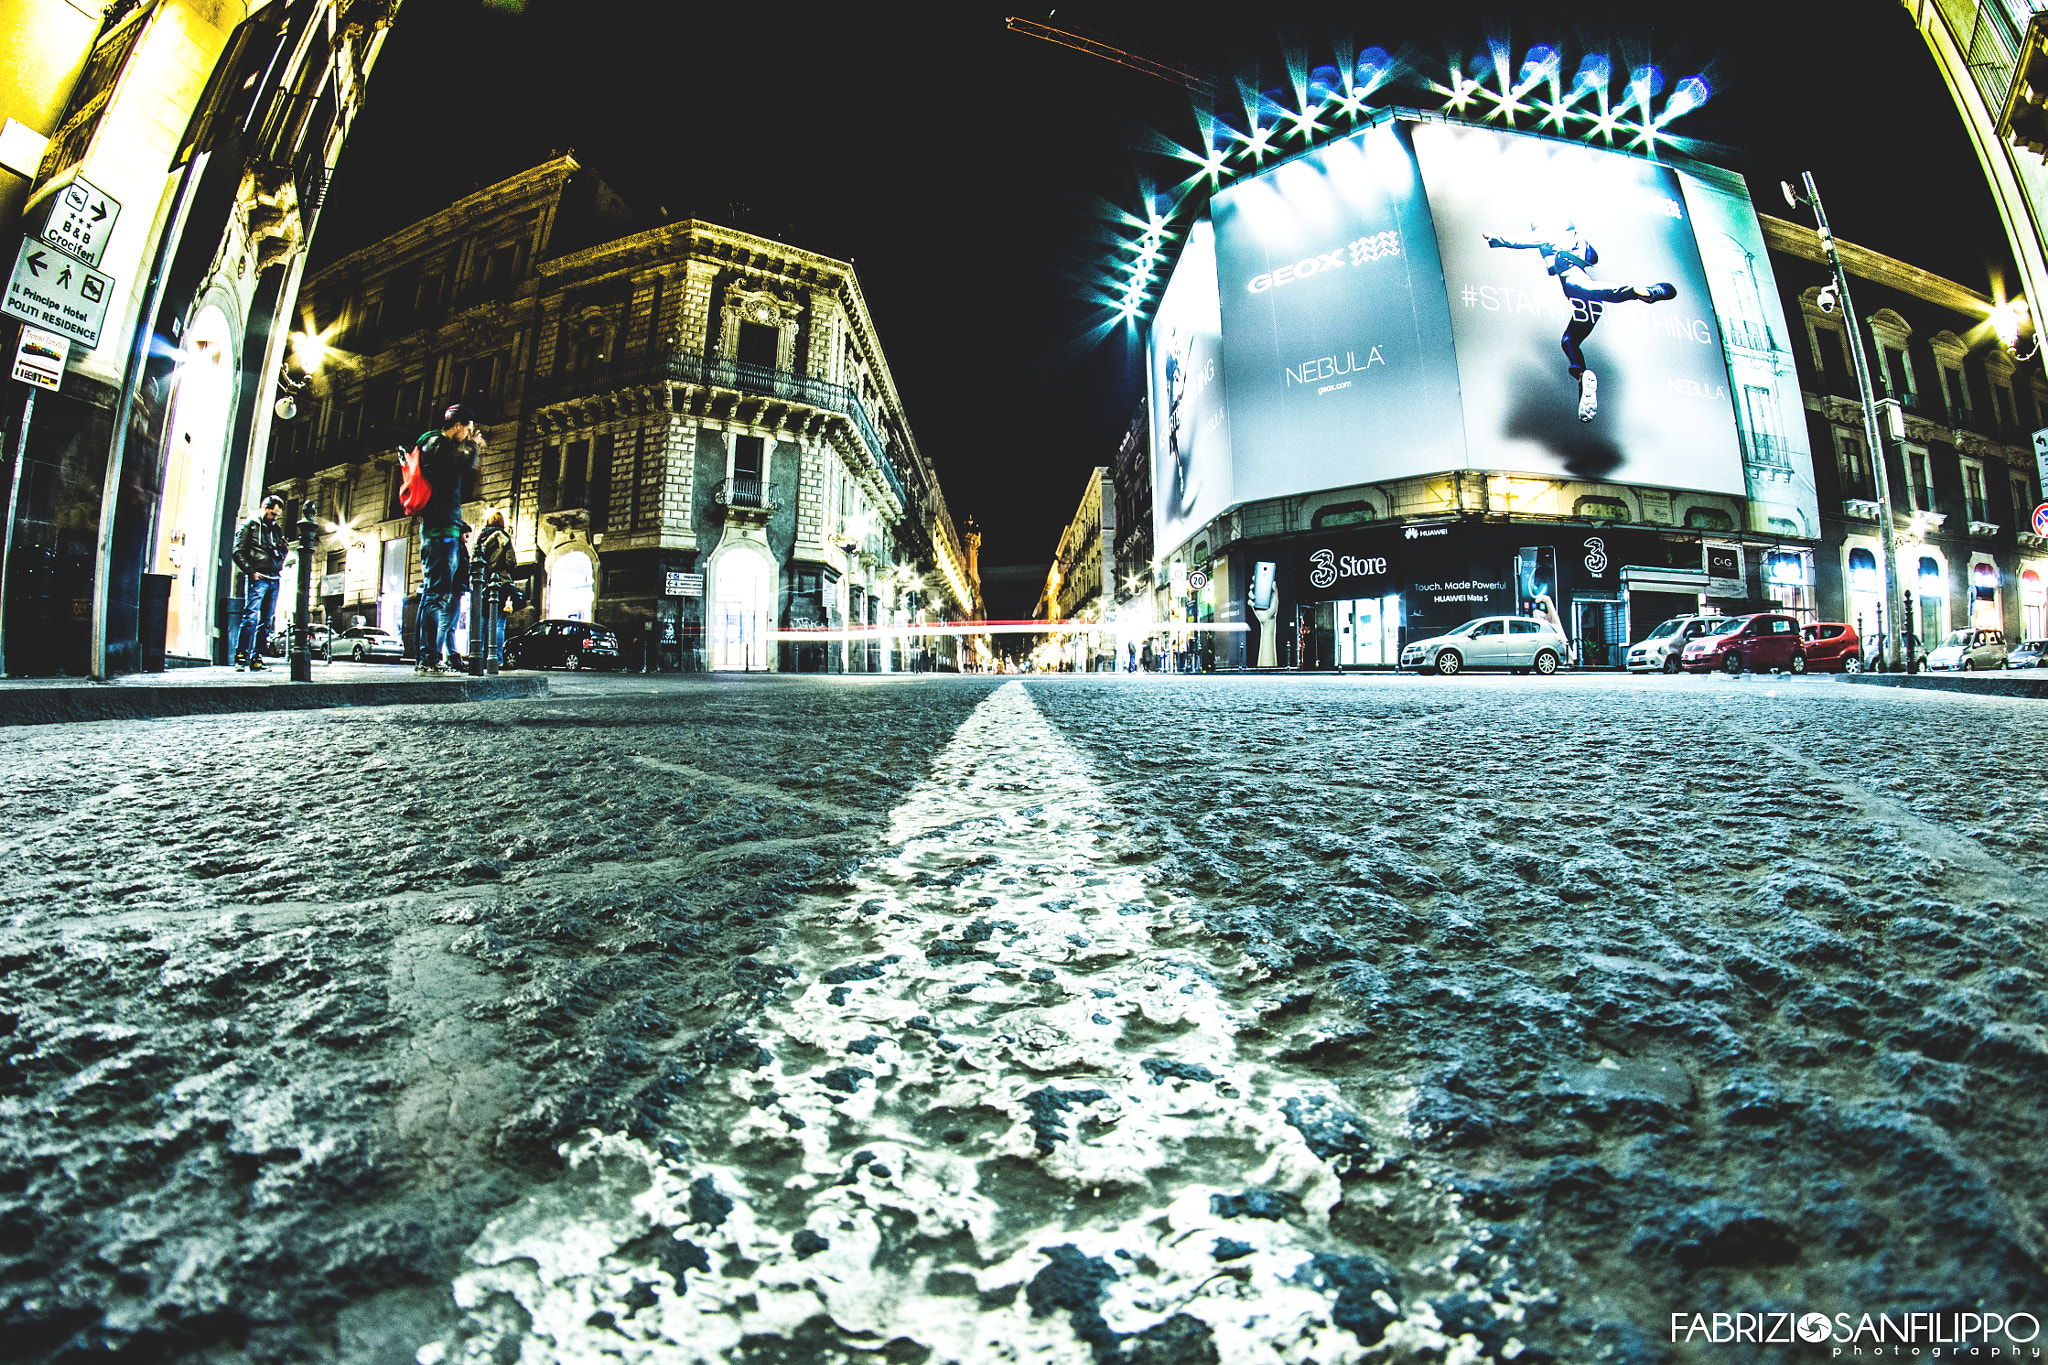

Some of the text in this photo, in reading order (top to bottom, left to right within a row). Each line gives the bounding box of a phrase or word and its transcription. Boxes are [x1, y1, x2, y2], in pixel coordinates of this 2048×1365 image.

[63, 220, 91, 244] B & B
[48, 229, 96, 263] Crociferi
[1247, 248, 1347, 293] GEOX
[22, 287, 60, 311] Principe
[62, 304, 88, 322] Hotel
[7, 296, 96, 341] POLITI RESIDENCE
[1286, 345, 1386, 388] NEBULA
[1318, 380, 1352, 395] geox.com
[1667, 377, 1726, 401] NEBULA
[1419, 528, 1448, 537] HUAWEI
[1339, 554, 1387, 578] Store
[1193, 576, 1204, 586] 20
[1414, 580, 1507, 592] Touch. Made Powerful
[1433, 594, 1489, 603] HUAWEI Mate S
